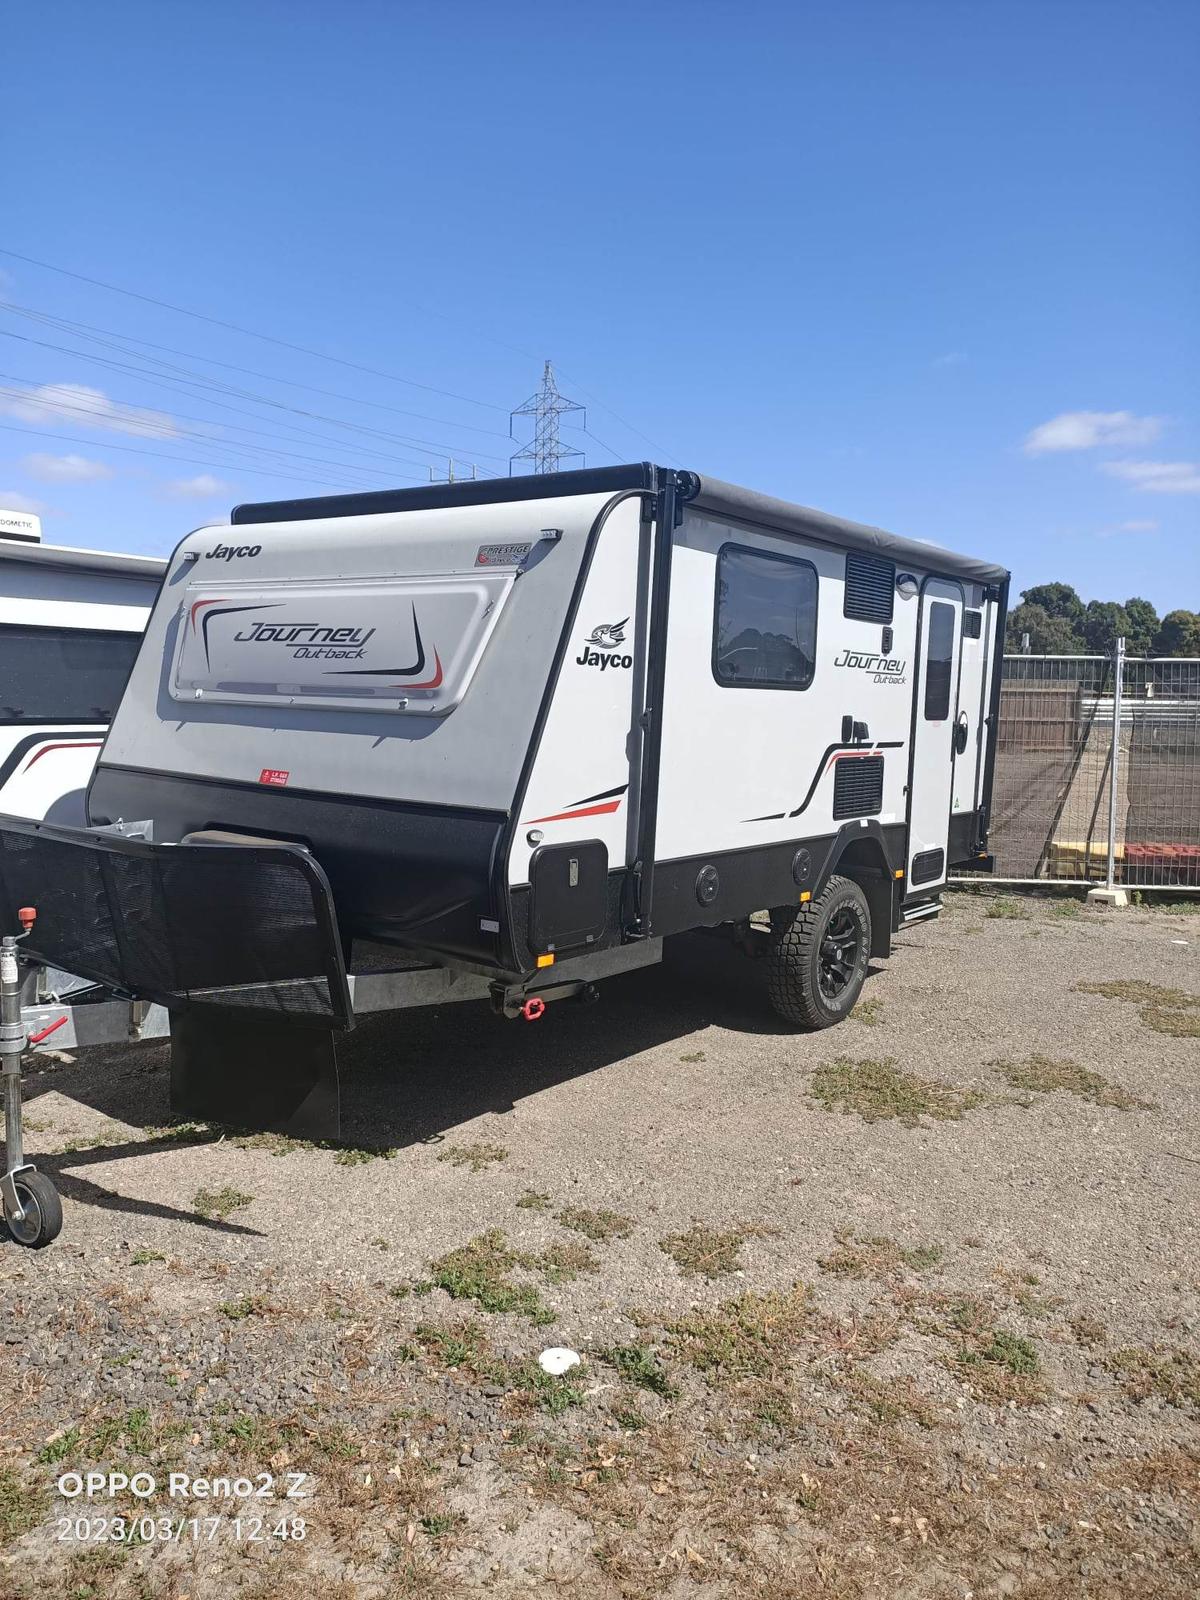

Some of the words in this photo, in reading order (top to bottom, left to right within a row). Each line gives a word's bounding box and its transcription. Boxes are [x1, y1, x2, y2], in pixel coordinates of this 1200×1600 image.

[0, 519, 32, 528] DOMETIC
[205, 543, 262, 562] Jayco
[486, 545, 530, 554] PRESTIGE
[234, 622, 376, 648] Journey
[293, 648, 368, 659] Outback
[576, 646, 633, 671] Jayco
[834, 649, 906, 675] Journey
[873, 675, 907, 684] Outback
